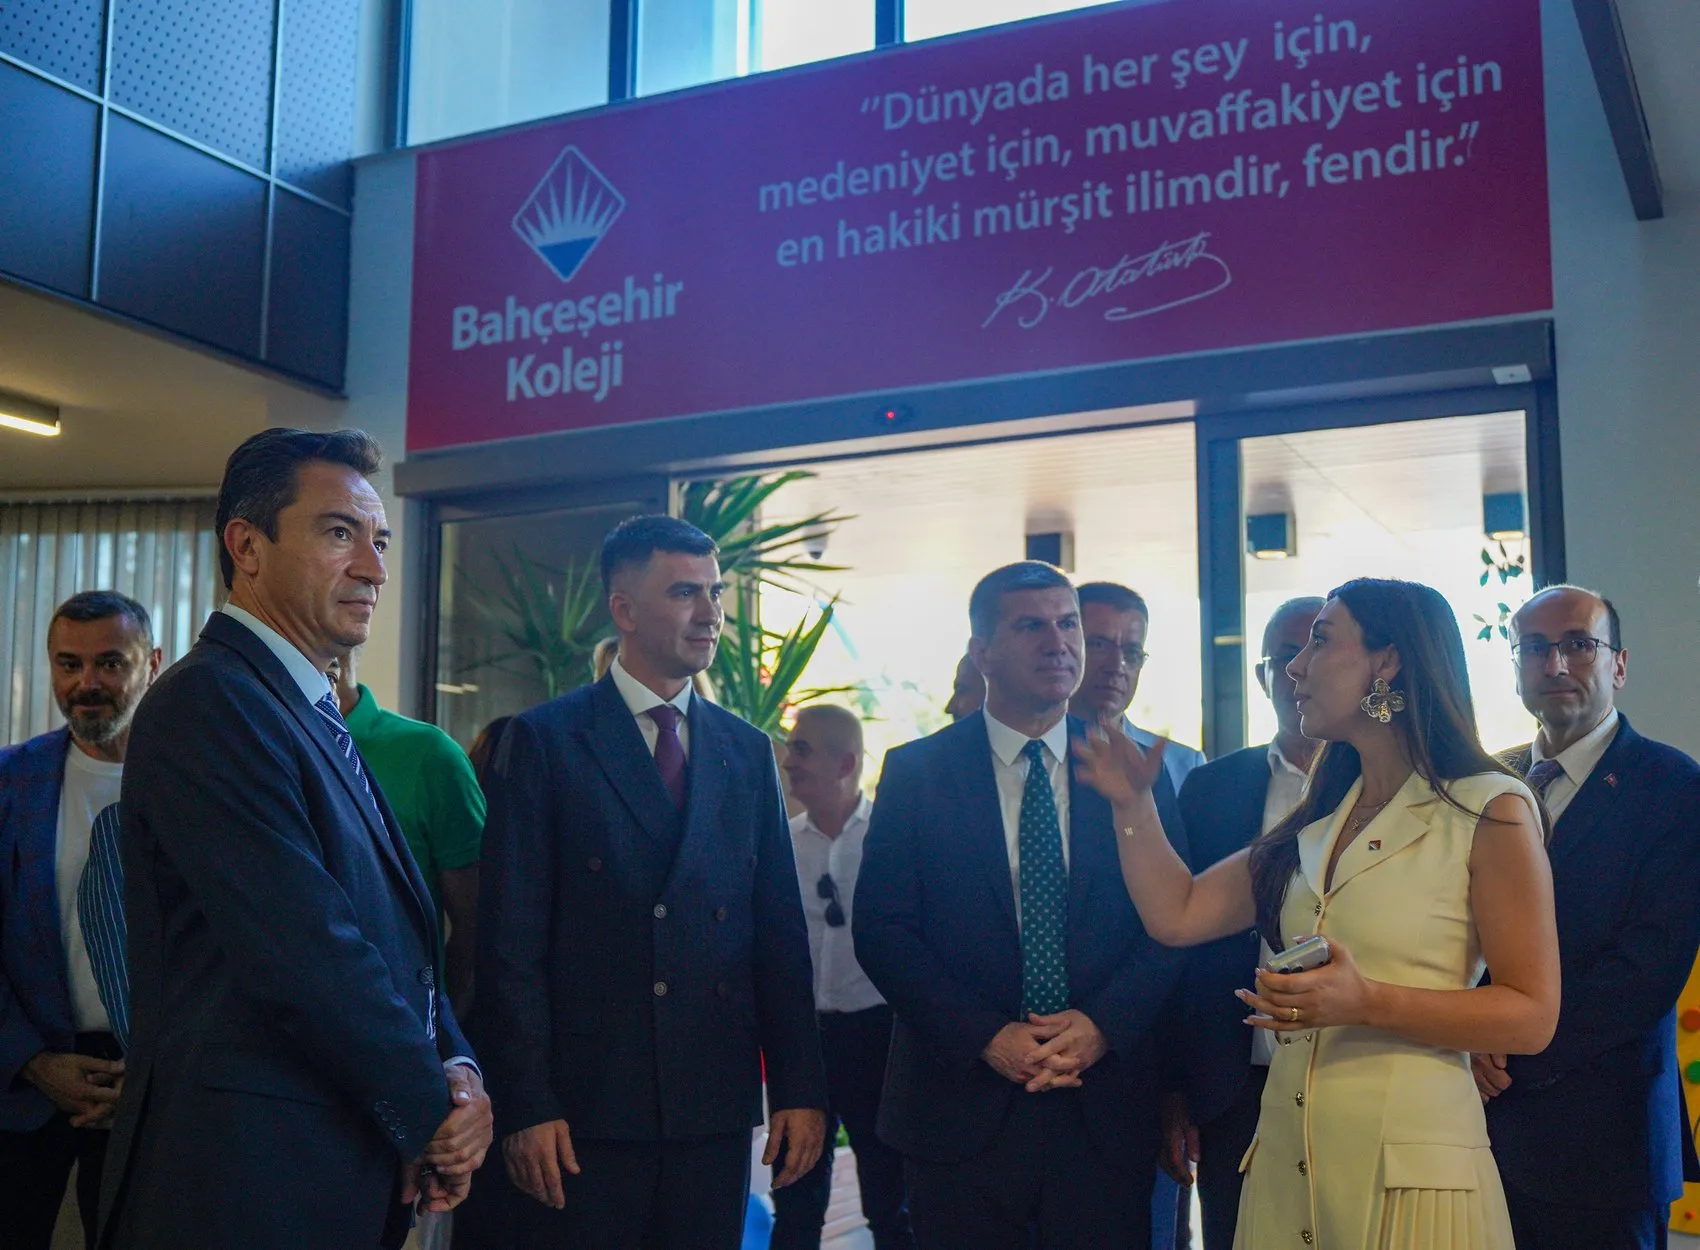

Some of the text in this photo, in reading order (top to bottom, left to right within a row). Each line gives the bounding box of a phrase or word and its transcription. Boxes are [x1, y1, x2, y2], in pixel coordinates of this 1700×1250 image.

[1083, 53, 1160, 95] her
[1171, 37, 1249, 89] şey
[1274, 13, 1373, 70] için,
[759, 54, 1503, 212] medeniyet için, muvaffakiyet için
[776, 235, 825, 268] en
[837, 201, 961, 258] hakiki
[973, 180, 1113, 238] mürşit
[1126, 155, 1290, 215] ilimdir,
[451, 271, 685, 352] Bahçeşehir
[506, 340, 624, 403] Koleji
